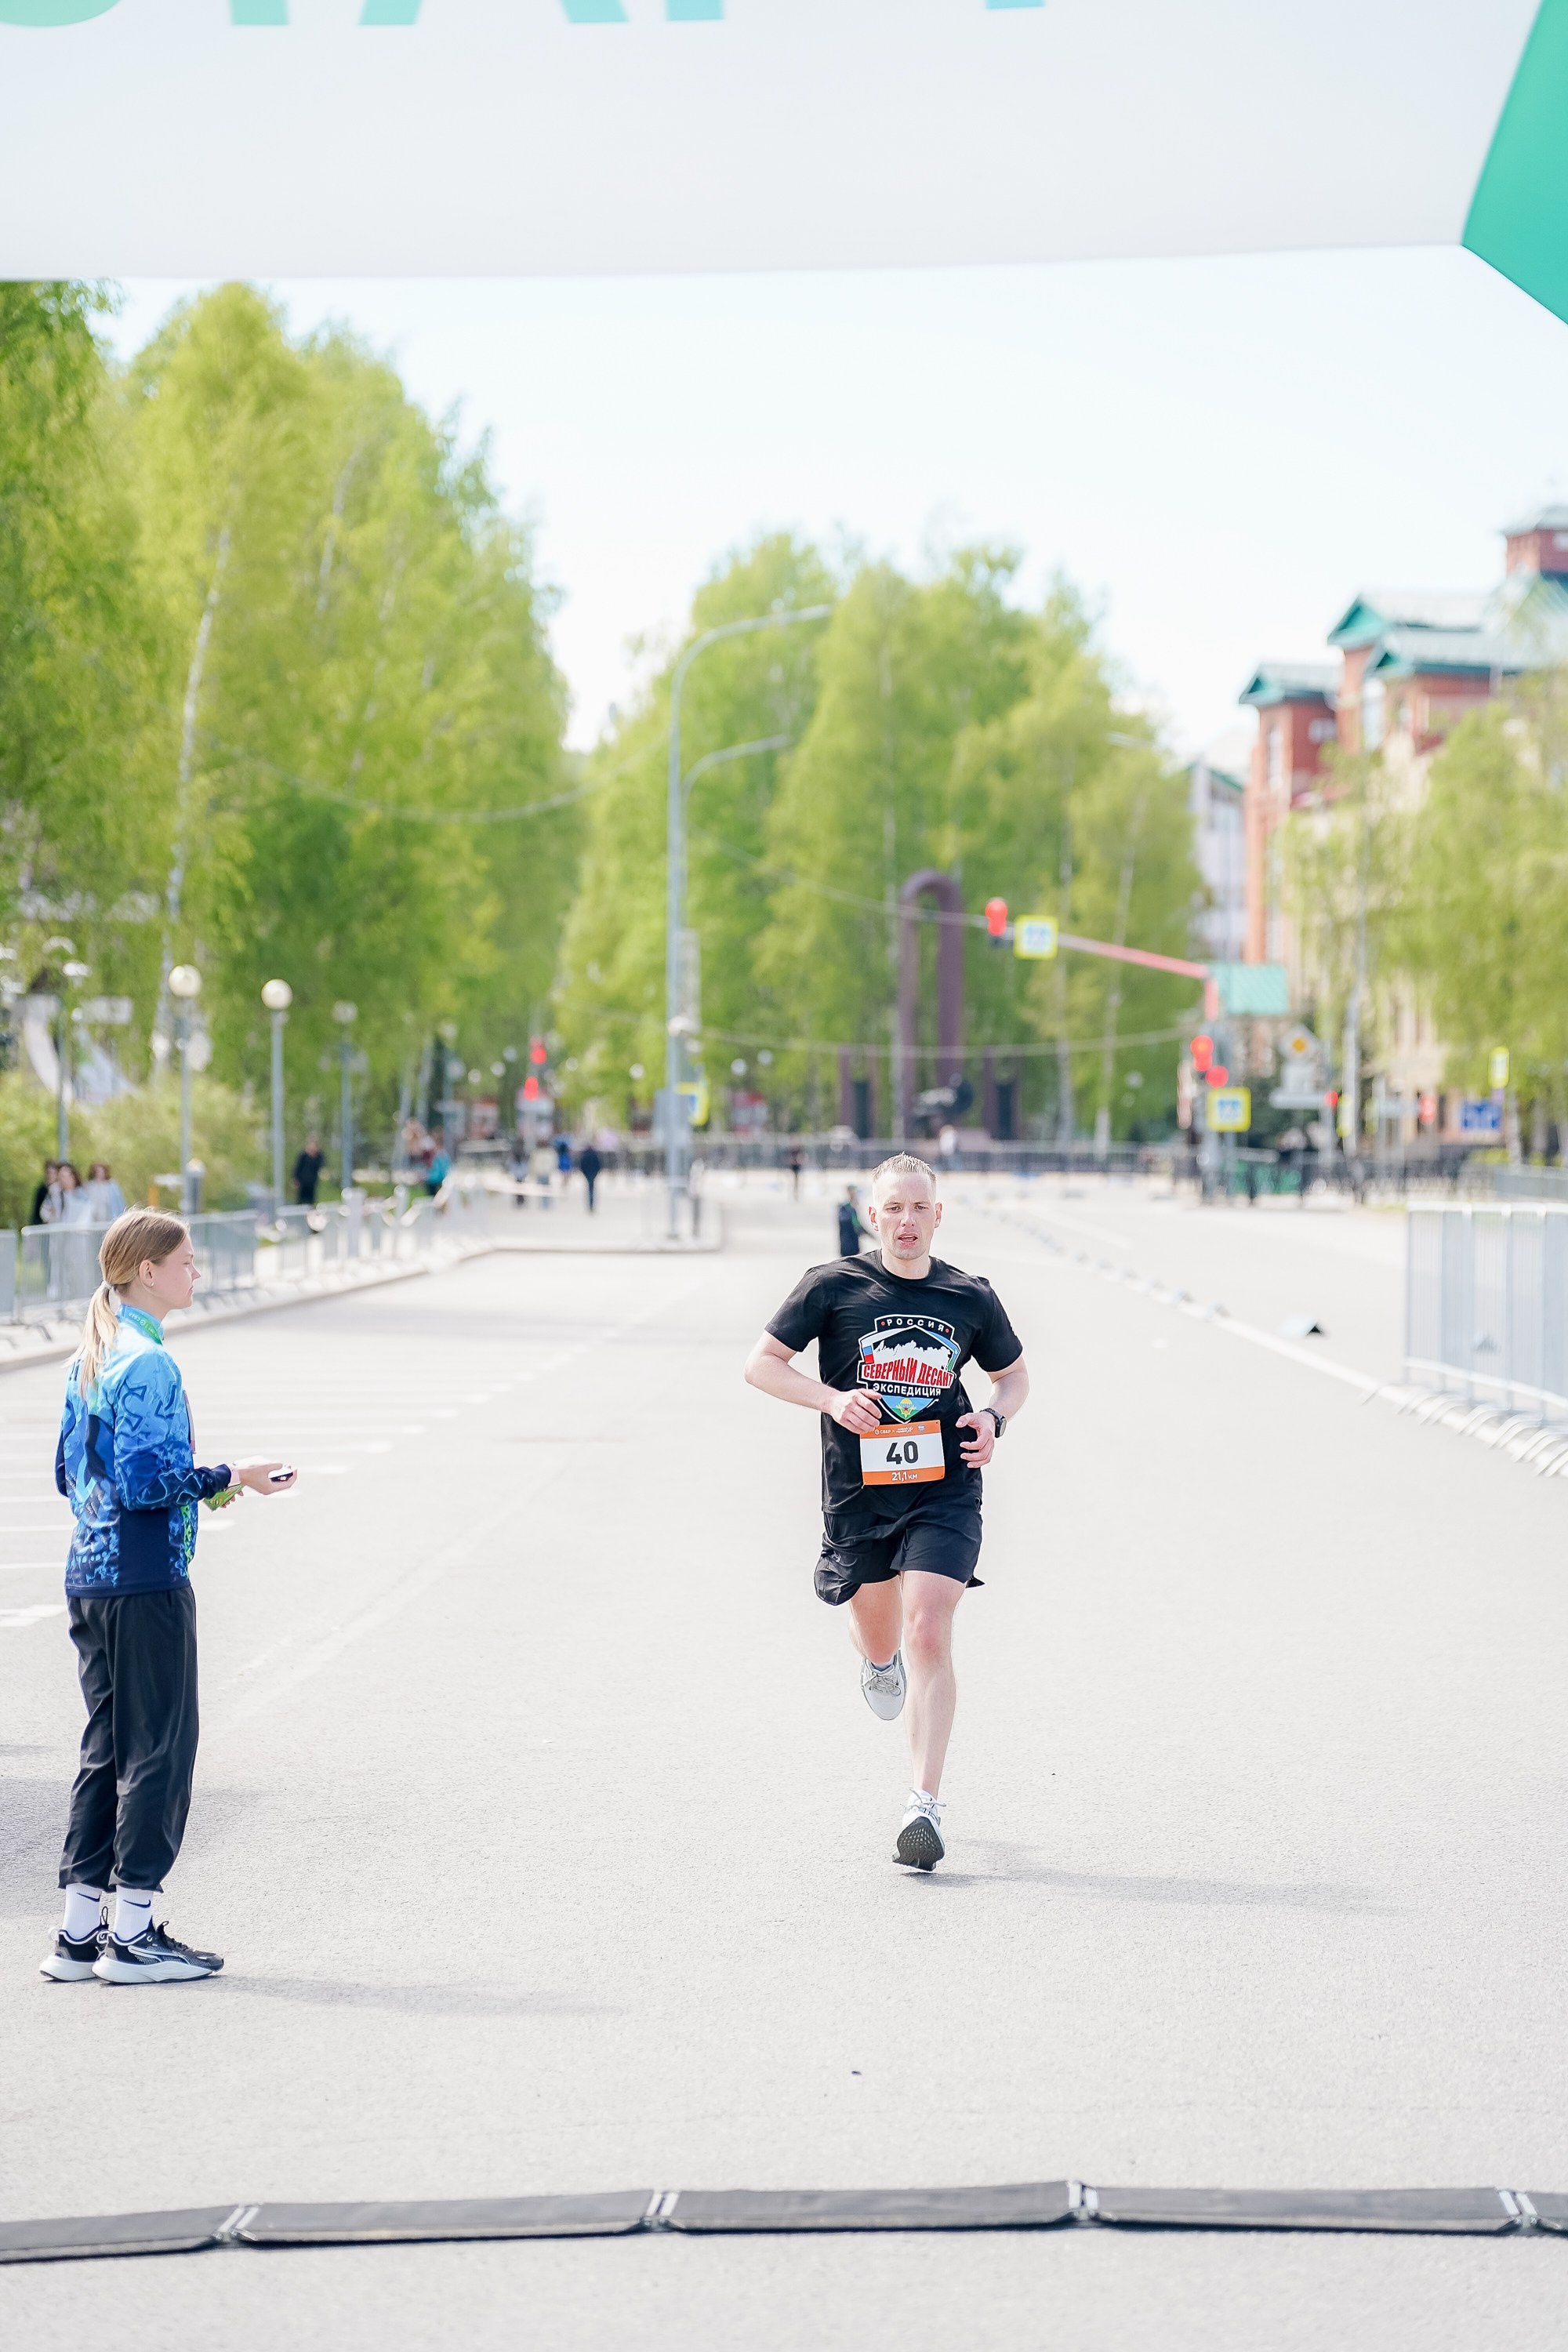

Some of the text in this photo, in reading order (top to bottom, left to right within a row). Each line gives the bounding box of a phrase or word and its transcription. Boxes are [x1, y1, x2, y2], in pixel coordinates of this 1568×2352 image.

[886, 1318, 945, 1332] РОССИЯ
[916, 1363, 953, 1387] ДЕСАНТ
[873, 1383, 941, 1397] ЭКСПЕДИЦИЯ
[886, 1441, 919, 1465] 40
